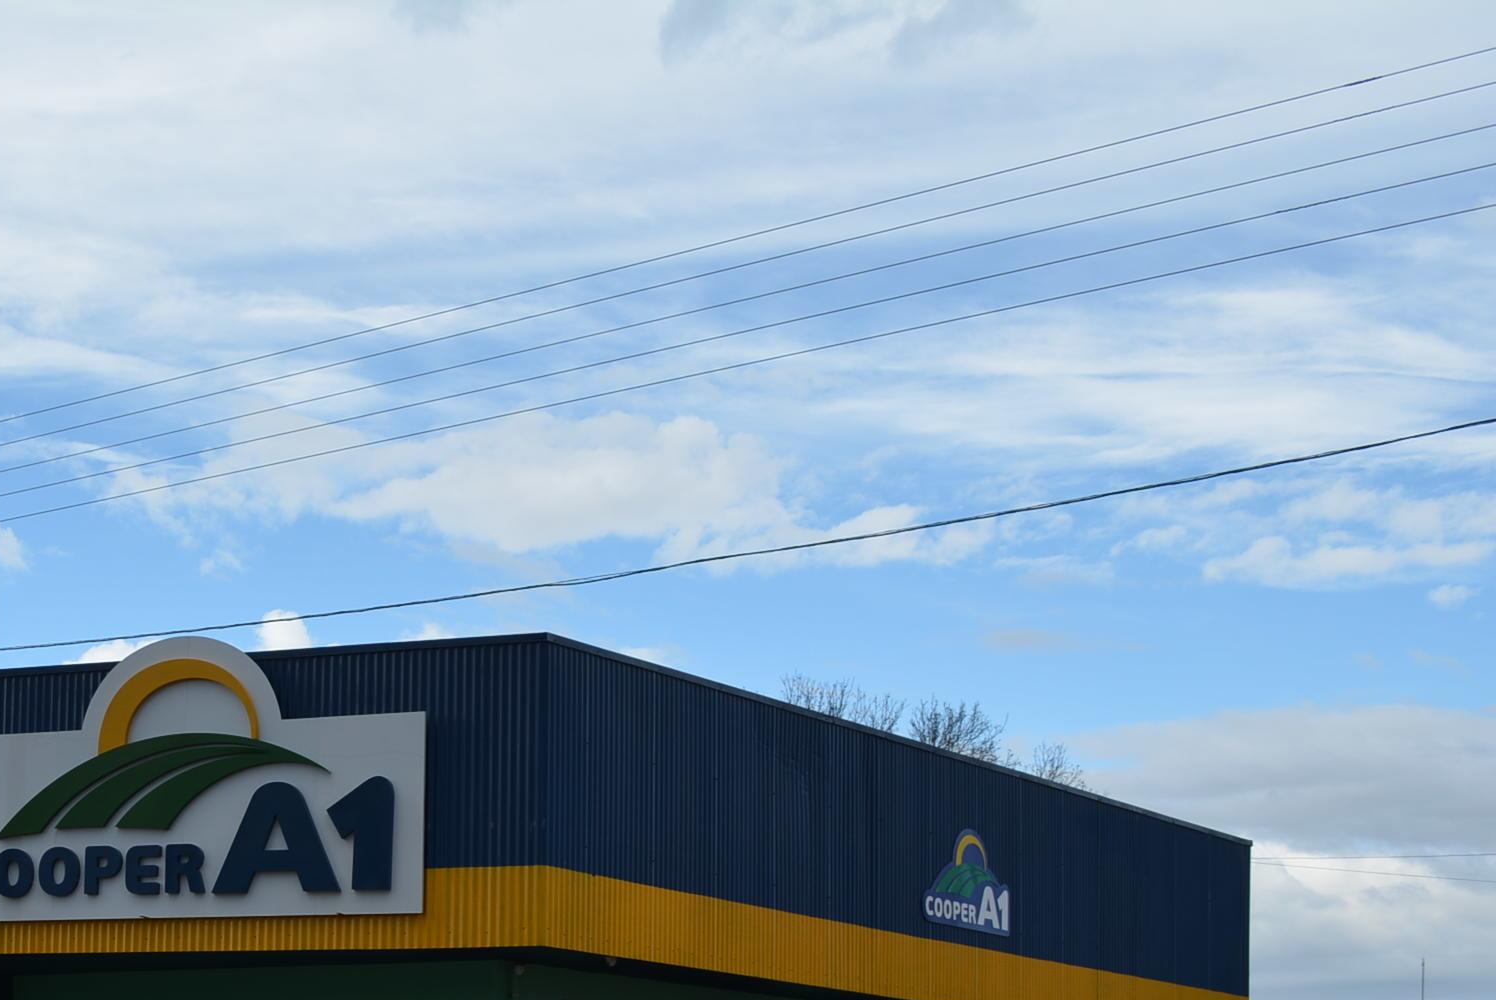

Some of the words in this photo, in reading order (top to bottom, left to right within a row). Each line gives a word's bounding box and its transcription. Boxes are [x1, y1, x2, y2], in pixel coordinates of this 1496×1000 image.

[212, 775, 396, 894] A1
[925, 895, 977, 925] COOPER
[977, 886, 1009, 931] A1
